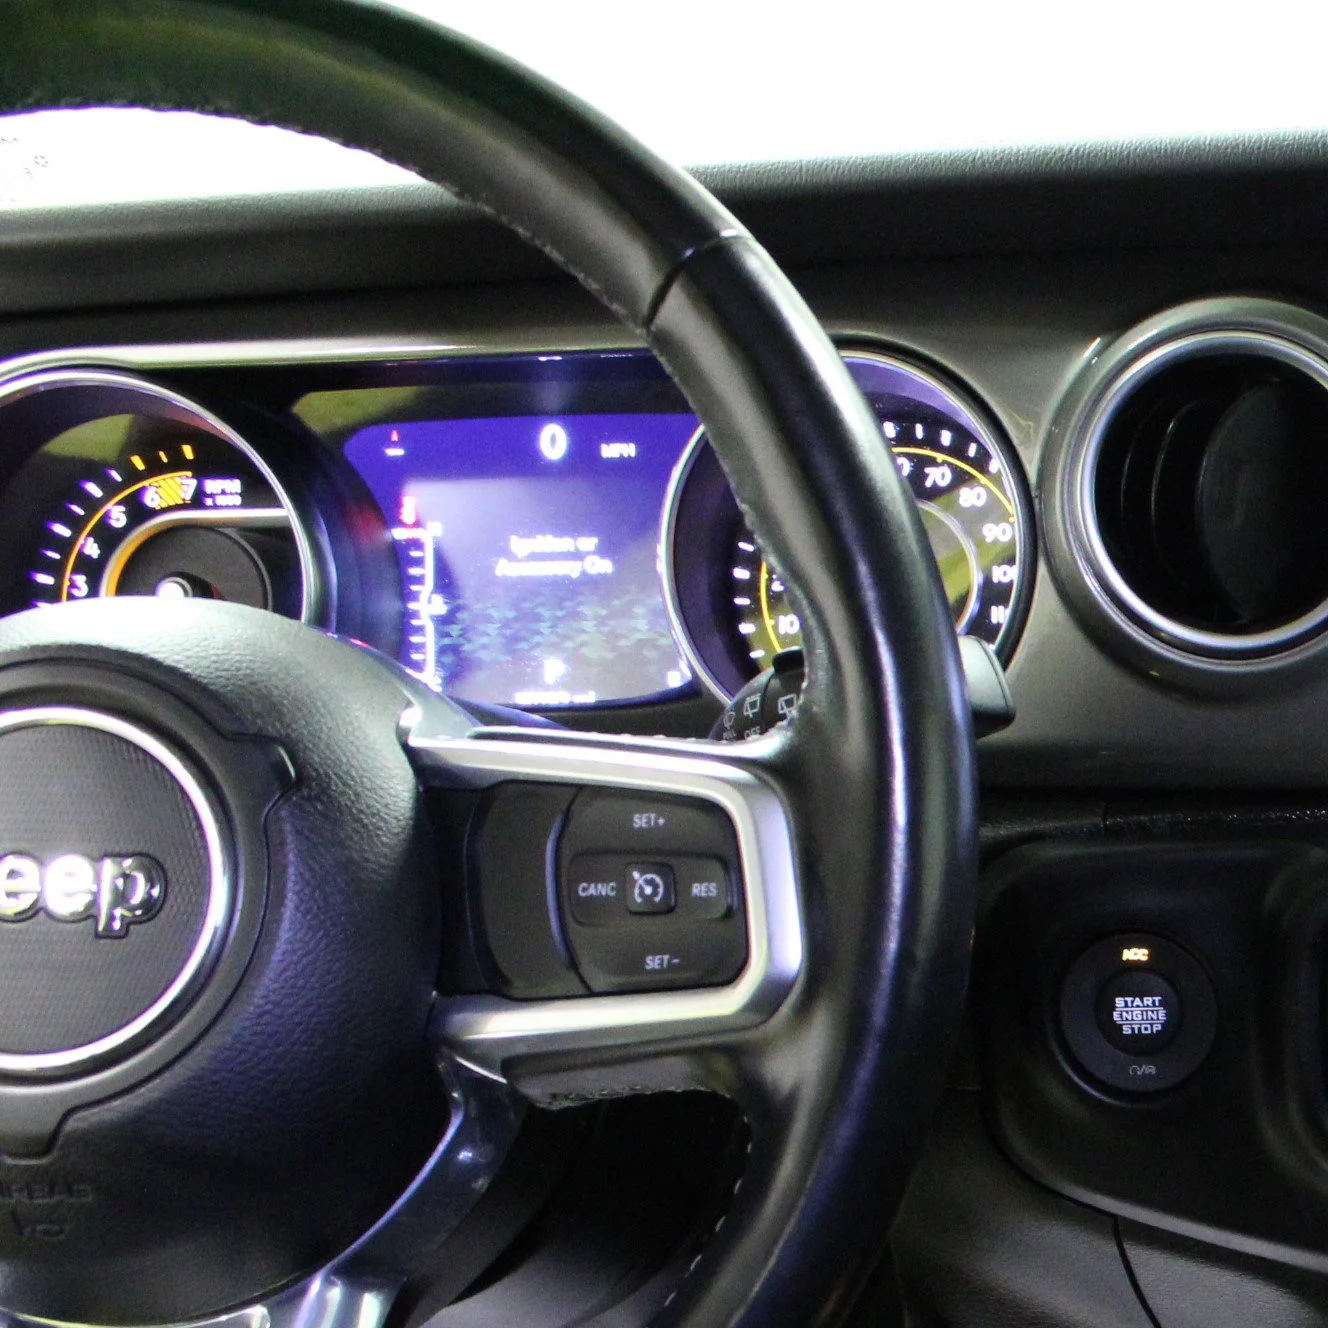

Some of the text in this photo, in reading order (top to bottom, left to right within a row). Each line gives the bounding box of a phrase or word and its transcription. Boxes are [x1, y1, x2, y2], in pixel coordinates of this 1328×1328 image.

[539, 424, 567, 460] 0
[601, 443, 635, 458] MPH
[204, 478, 241, 495] RPM
[924, 466, 952, 487] 70
[143, 485, 161, 508] 6
[182, 478, 197, 501] 7
[959, 486, 987, 507] 80
[107, 505, 127, 528] 5
[983, 522, 1013, 542] 90
[83, 537, 101, 559] 4
[583, 555, 613, 575] On
[991, 564, 1016, 583] 10
[71, 574, 89, 597] 3
[778, 614, 800, 634] 10
[632, 813, 666, 828] SET+
[0, 854, 168, 938] eep
[577, 882, 617, 897] CANC
[691, 882, 717, 897] RES
[1122, 948, 1149, 961] ACC
[1115, 996, 1162, 1008] START
[1113, 1010, 1167, 1021] ENGINE
[1122, 1024, 1162, 1035] STOP
